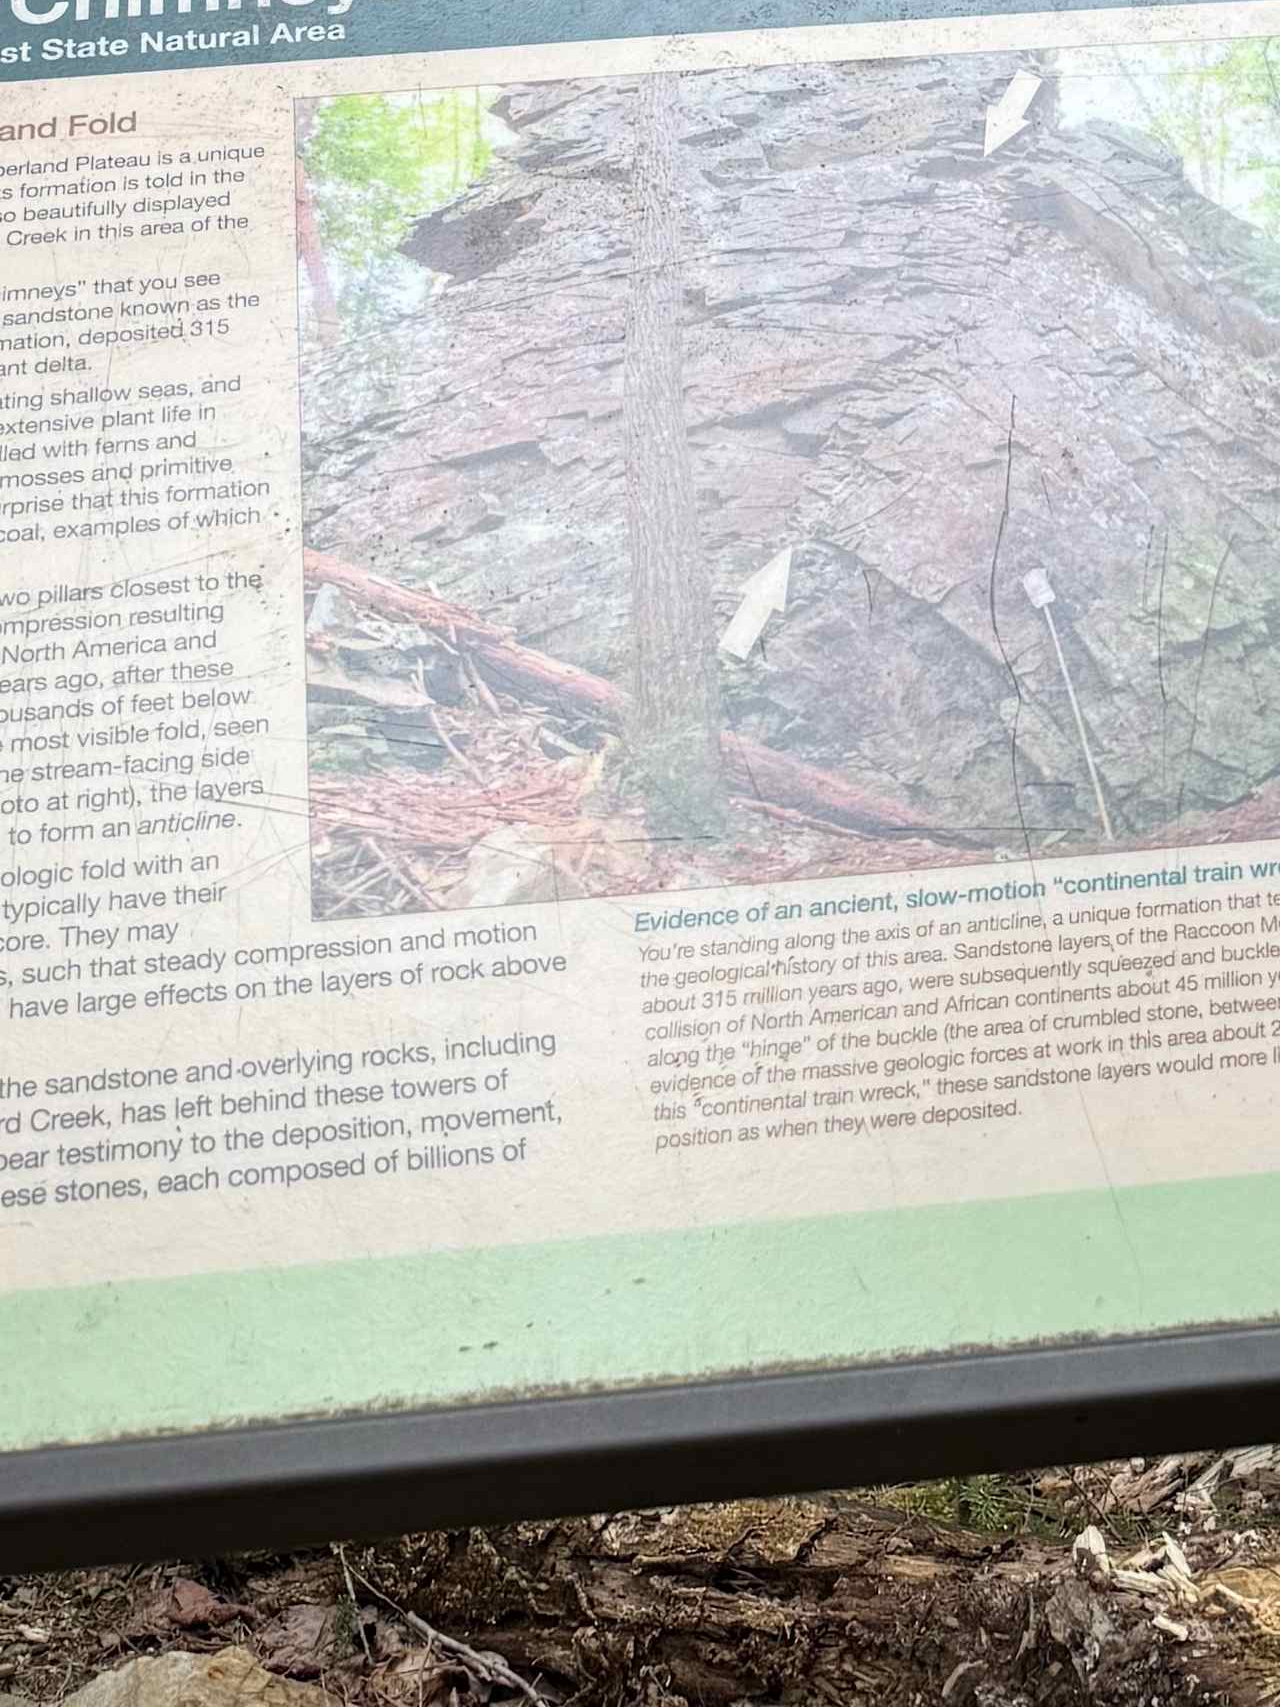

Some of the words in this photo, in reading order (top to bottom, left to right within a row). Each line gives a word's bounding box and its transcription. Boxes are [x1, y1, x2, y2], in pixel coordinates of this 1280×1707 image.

[40, 36, 129, 61] State
[140, 23, 261, 53] Natural
[269, 21, 348, 44] Area
[68, 110, 136, 136] Fold
[75, 154, 150, 171] Plateau
[157, 150, 173, 165] is
[178, 152, 192, 164] a
[197, 145, 266, 163] unique
[6, 227, 68, 246] Creek
[74, 225, 91, 241] in
[97, 223, 134, 239] this
[140, 221, 185, 236] area
[190, 215, 211, 232] of
[216, 214, 249, 230] the
[79, 322, 182, 347] deposited
[190, 318, 230, 336] 315
[50, 385, 131, 406] shallow
[137, 383, 194, 399] seas,
[200, 375, 240, 394] and
[42, 439, 88, 459] with
[94, 437, 149, 454] ferns
[155, 430, 196, 450] and
[128, 602, 223, 626] resulting
[53, 672, 104, 693] ago,
[111, 665, 165, 685] after
[170, 662, 234, 680] these
[101, 695, 124, 716] of
[131, 692, 174, 714] feet
[181, 688, 251, 710] below
[2, 893, 101, 924] typically
[108, 891, 166, 911] have
[173, 882, 227, 905] their
[632, 908, 739, 933] Evidence
[746, 901, 770, 923] of
[774, 903, 802, 920] an
[808, 892, 898, 918] ancient,
[905, 880, 1046, 909] slow-motion
[1193, 862, 1243, 884] train
[22, 959, 80, 984] such
[90, 955, 137, 978] that
[144, 948, 227, 974] steady
[236, 935, 392, 967] compression
[398, 928, 445, 952] and
[453, 922, 537, 947] motion
[645, 1018, 720, 1041] collision
[726, 1013, 746, 1034] of
[750, 1009, 803, 1031] North
[808, 1003, 898, 1026] American
[902, 996, 938, 1018] and
[944, 993, 1010, 1014] African
[1014, 983, 1113, 1008] continents
[1116, 977, 1170, 999] about
[1175, 973, 1199, 992] 45
[1204, 969, 1262, 990] million
[57, 1137, 184, 1166] testimony
[190, 1133, 216, 1154] to
[223, 1128, 265, 1151] the
[273, 1116, 411, 1150] deposition,
[422, 1102, 562, 1133] movement,
